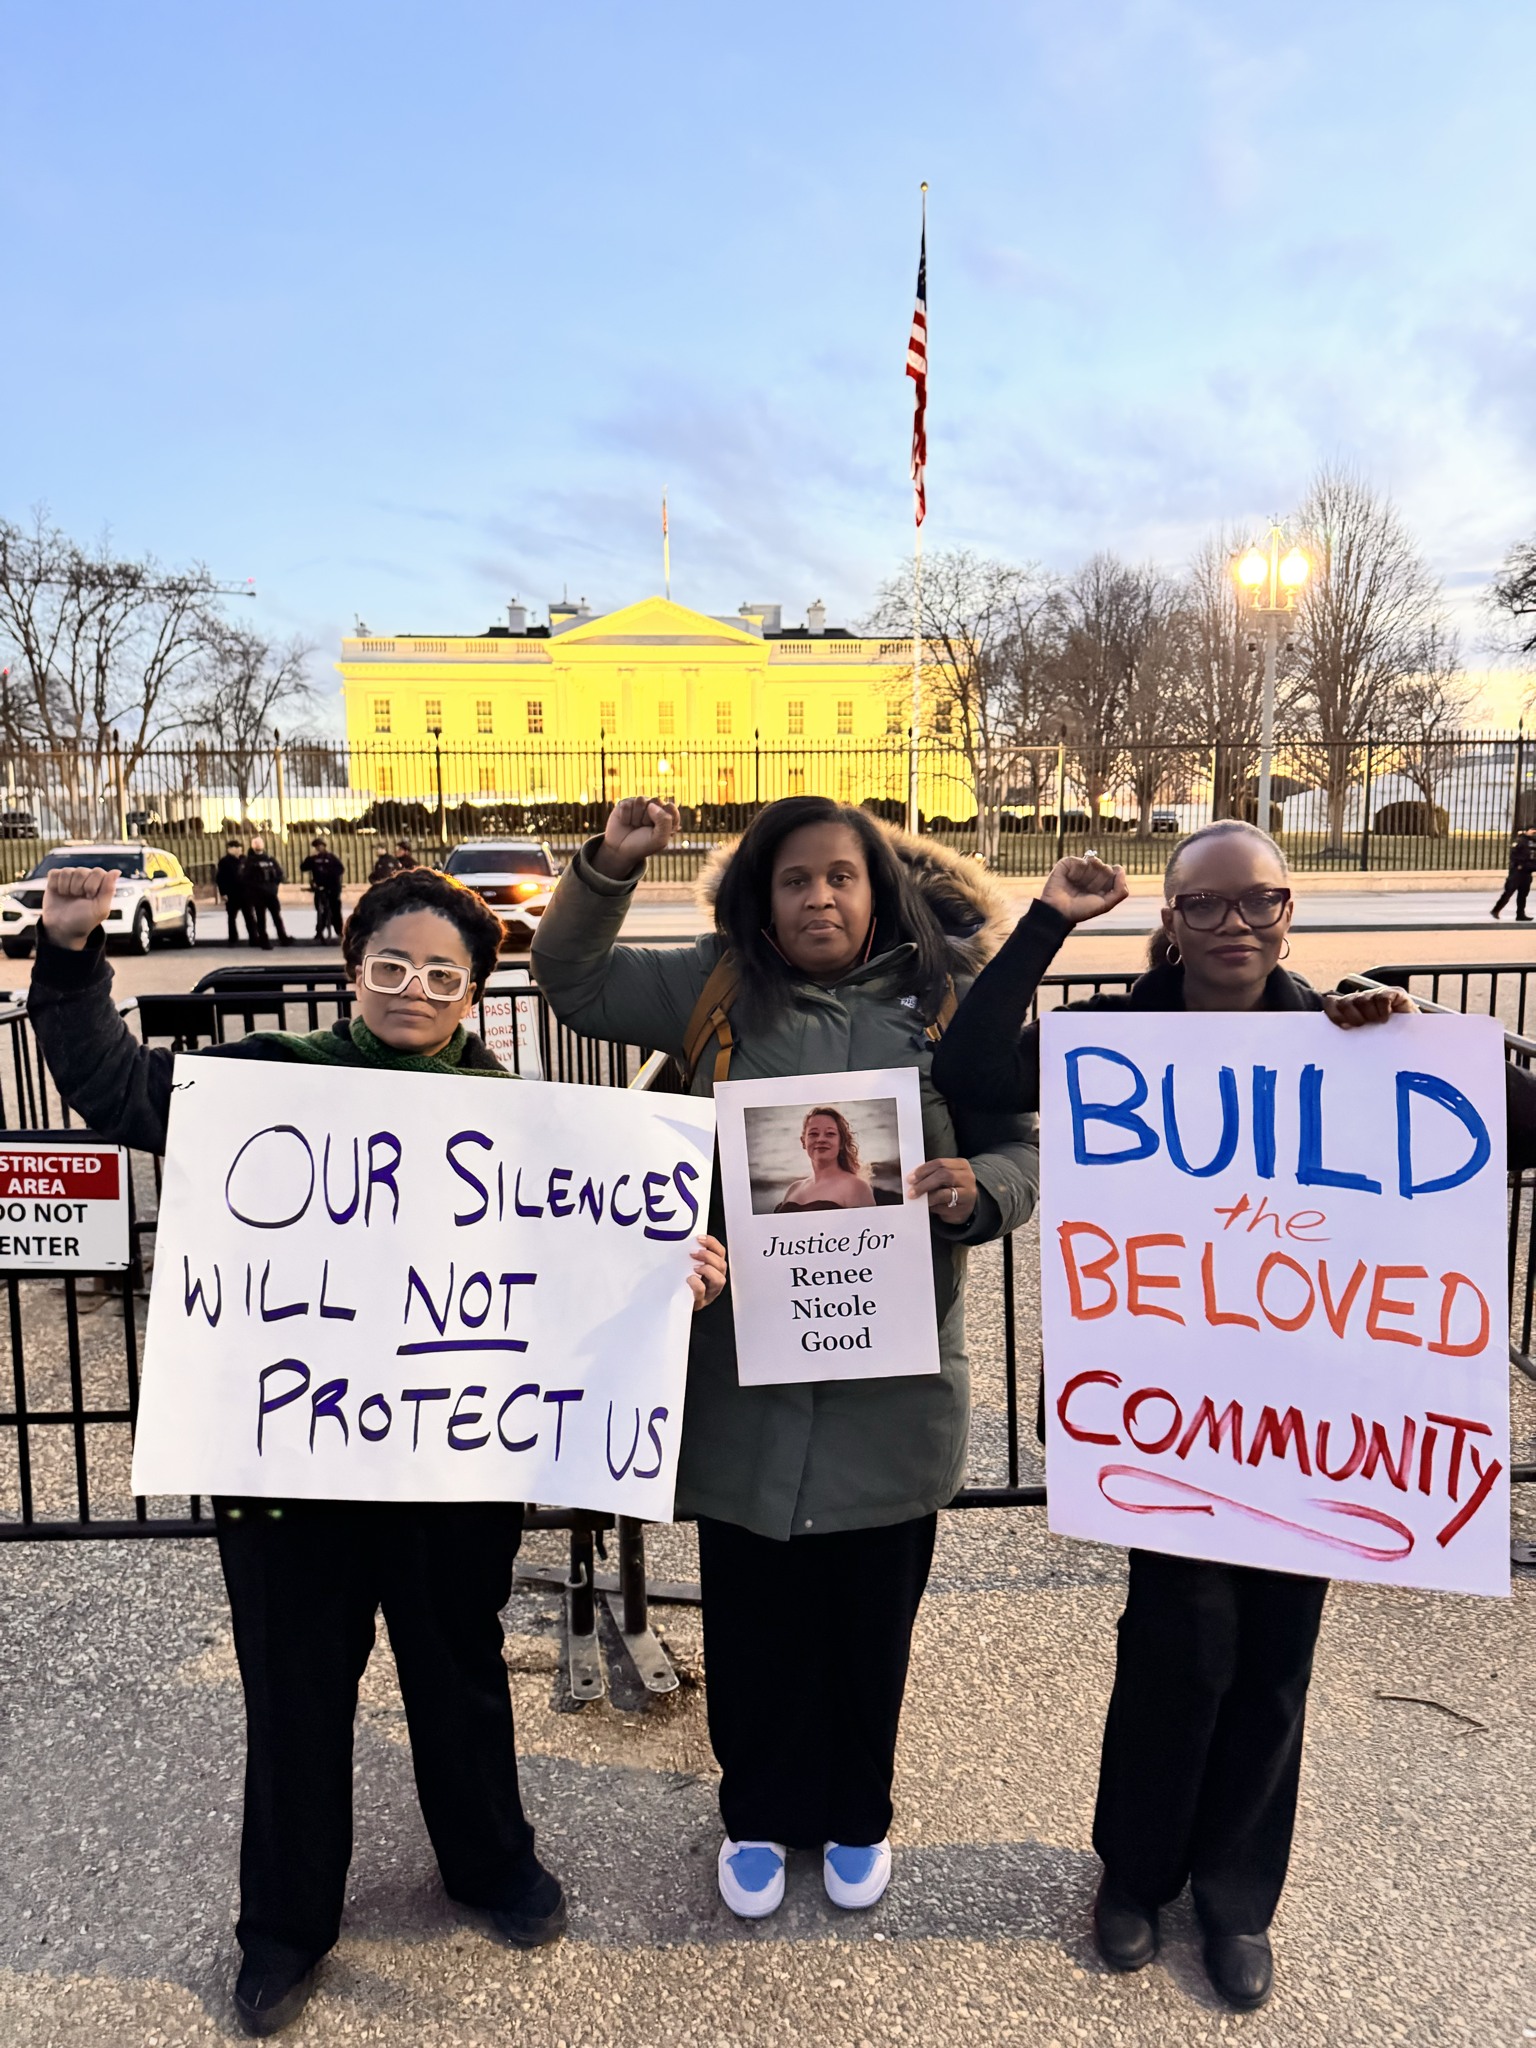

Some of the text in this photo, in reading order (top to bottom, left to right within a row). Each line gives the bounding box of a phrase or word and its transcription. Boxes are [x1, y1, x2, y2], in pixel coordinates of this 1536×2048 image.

[488, 1038, 528, 1050] SONNEL
[496, 1052, 513, 1062] NLY
[1064, 1046, 1491, 1200] BUILD
[0, 1155, 102, 1174] STRICTED
[7, 1178, 66, 1195] AREA
[225, 1124, 700, 1242] OUR SILENCES
[34, 1203, 88, 1223] NOT
[1214, 1193, 1333, 1243] the
[0, 1235, 80, 1257] ENTER
[762, 1228, 895, 1258] Justice for
[789, 1266, 874, 1288] Renee
[1057, 1220, 1490, 1358] BELOVED
[183, 1255, 538, 1337] WILL NOT
[790, 1294, 877, 1320] Nicole
[801, 1326, 873, 1353] Good
[257, 1358, 669, 1482] PROTECT US
[1056, 1369, 1503, 1549] COMMUNITY
